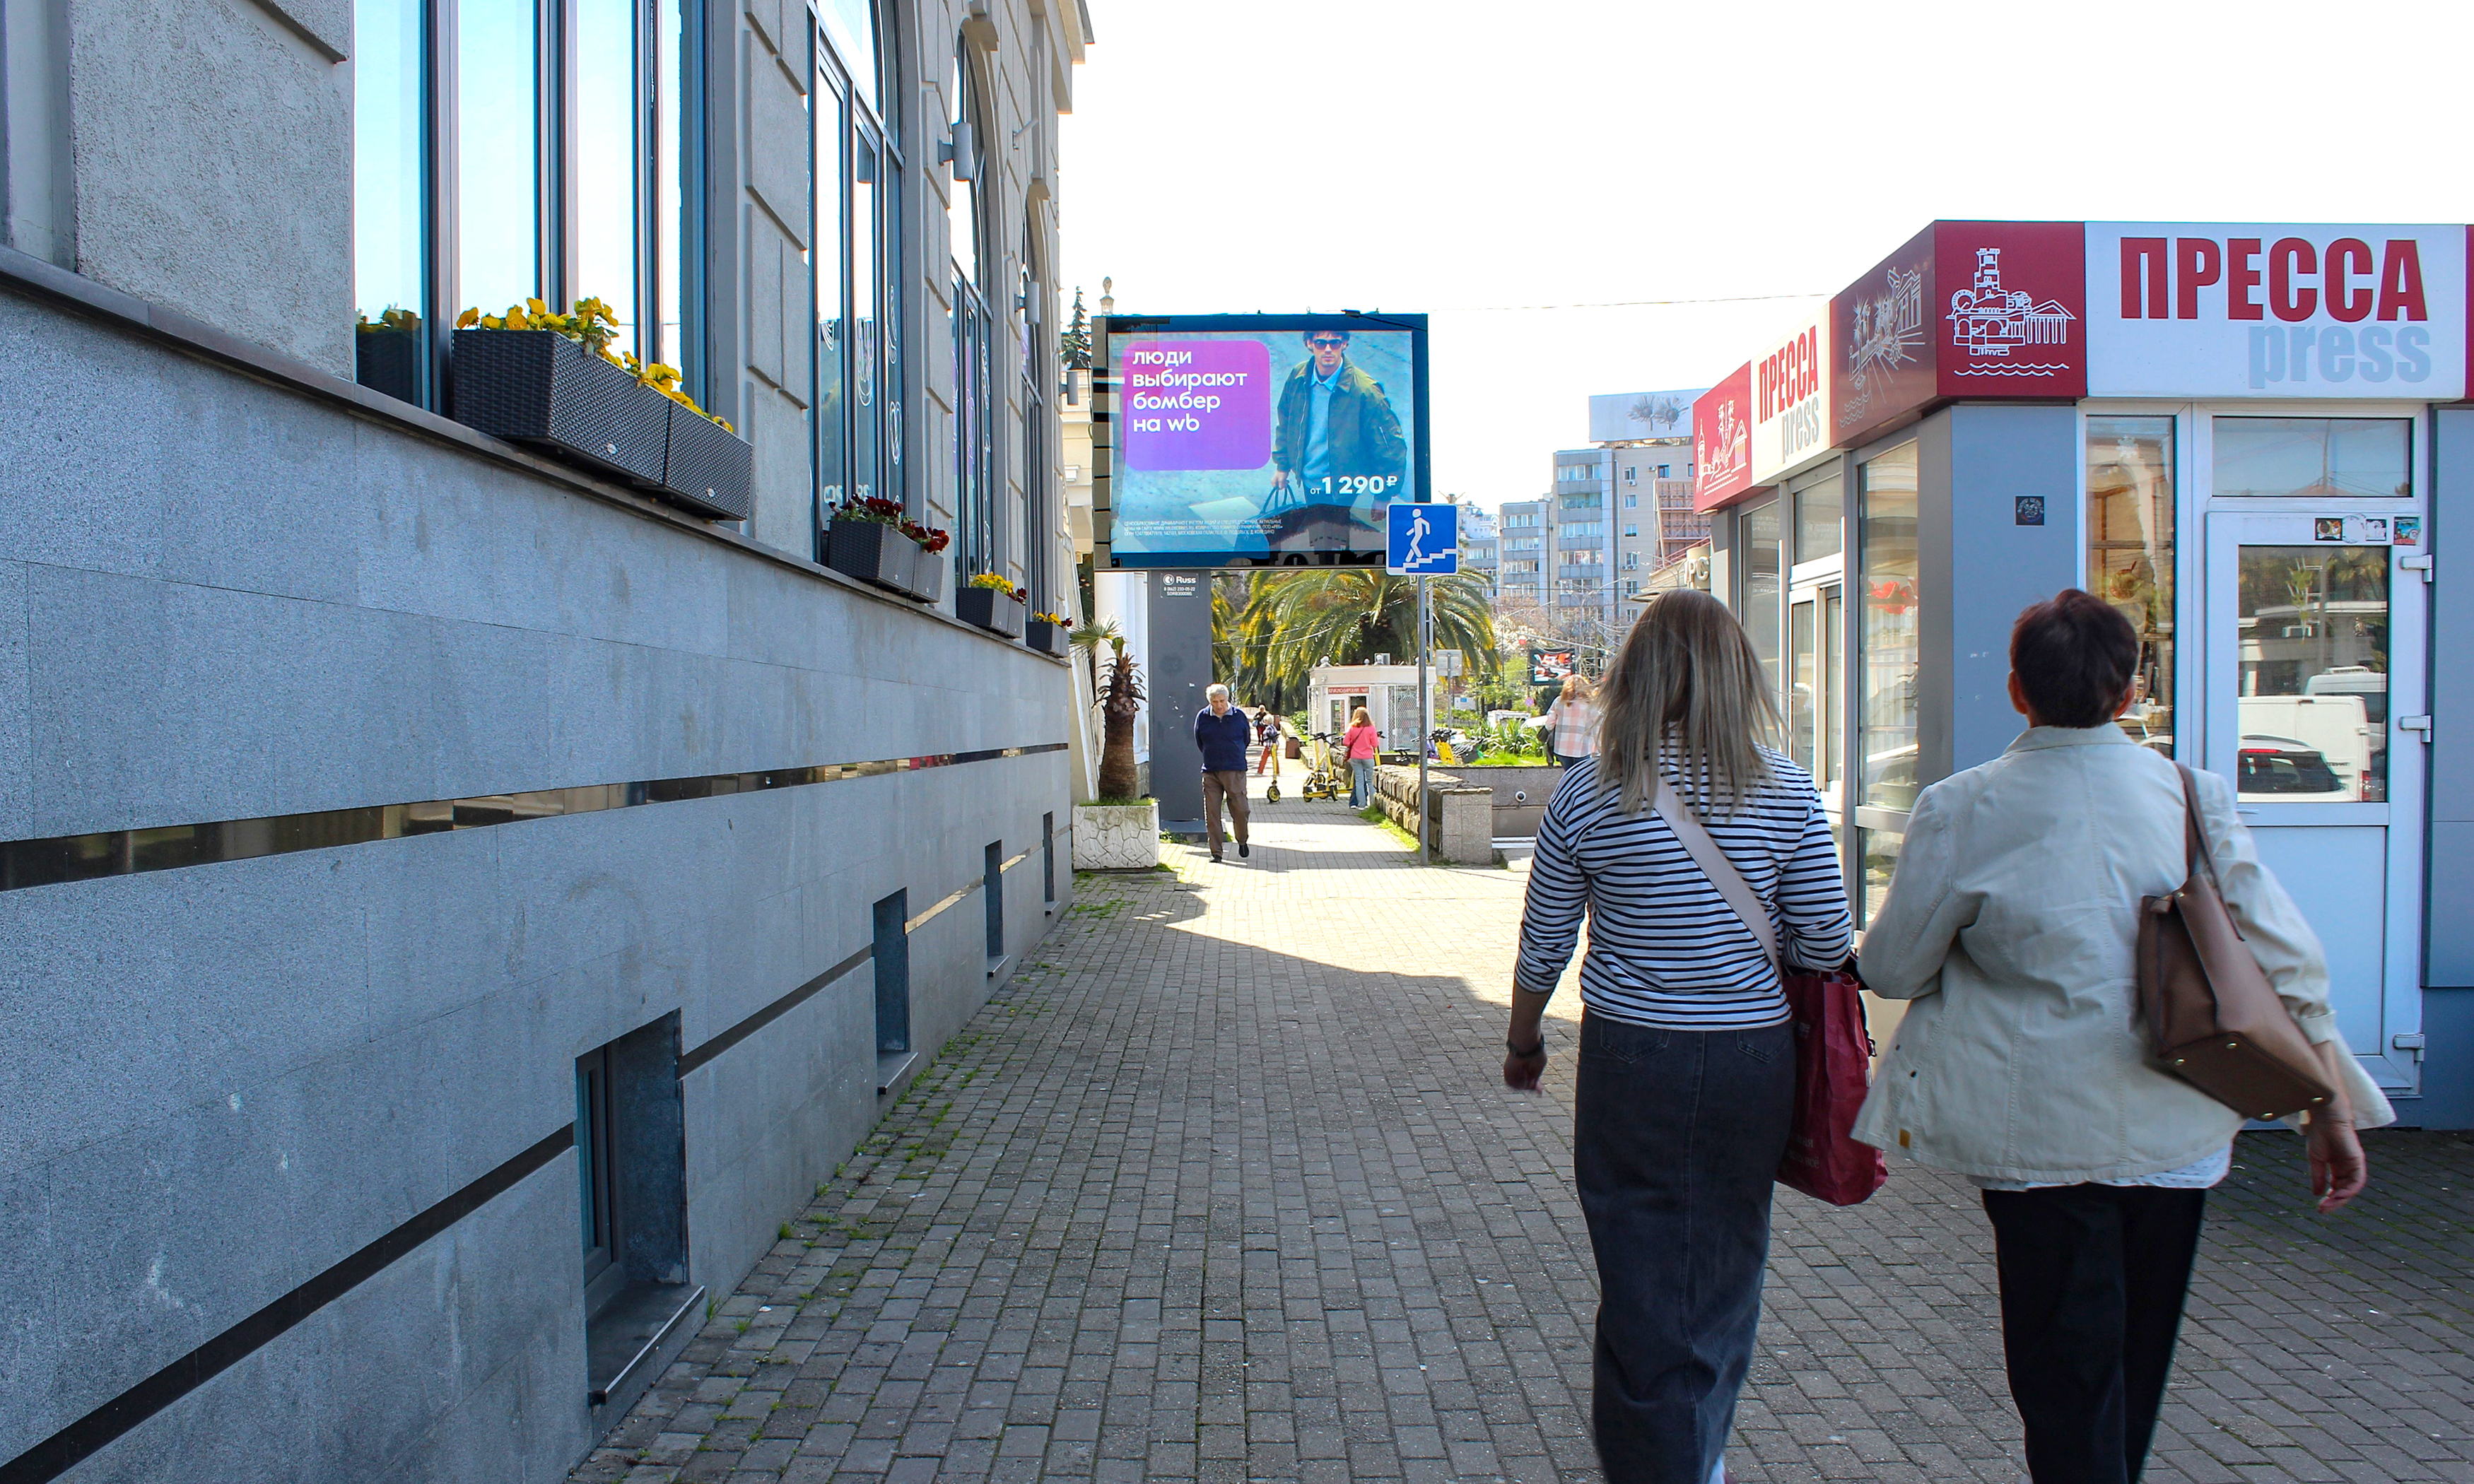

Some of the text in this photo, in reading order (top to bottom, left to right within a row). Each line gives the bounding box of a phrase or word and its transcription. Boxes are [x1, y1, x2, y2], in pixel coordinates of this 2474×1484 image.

[2121, 237, 2428, 323] ПРЕССА
[1132, 351, 1192, 367] люди
[1759, 324, 1819, 424] ПРЕССА
[2248, 325, 2432, 389] press
[1132, 368, 1248, 391] выбирают
[1133, 391, 1221, 413] бомбер
[1133, 413, 1200, 432] на wb
[1782, 396, 1819, 464] press
